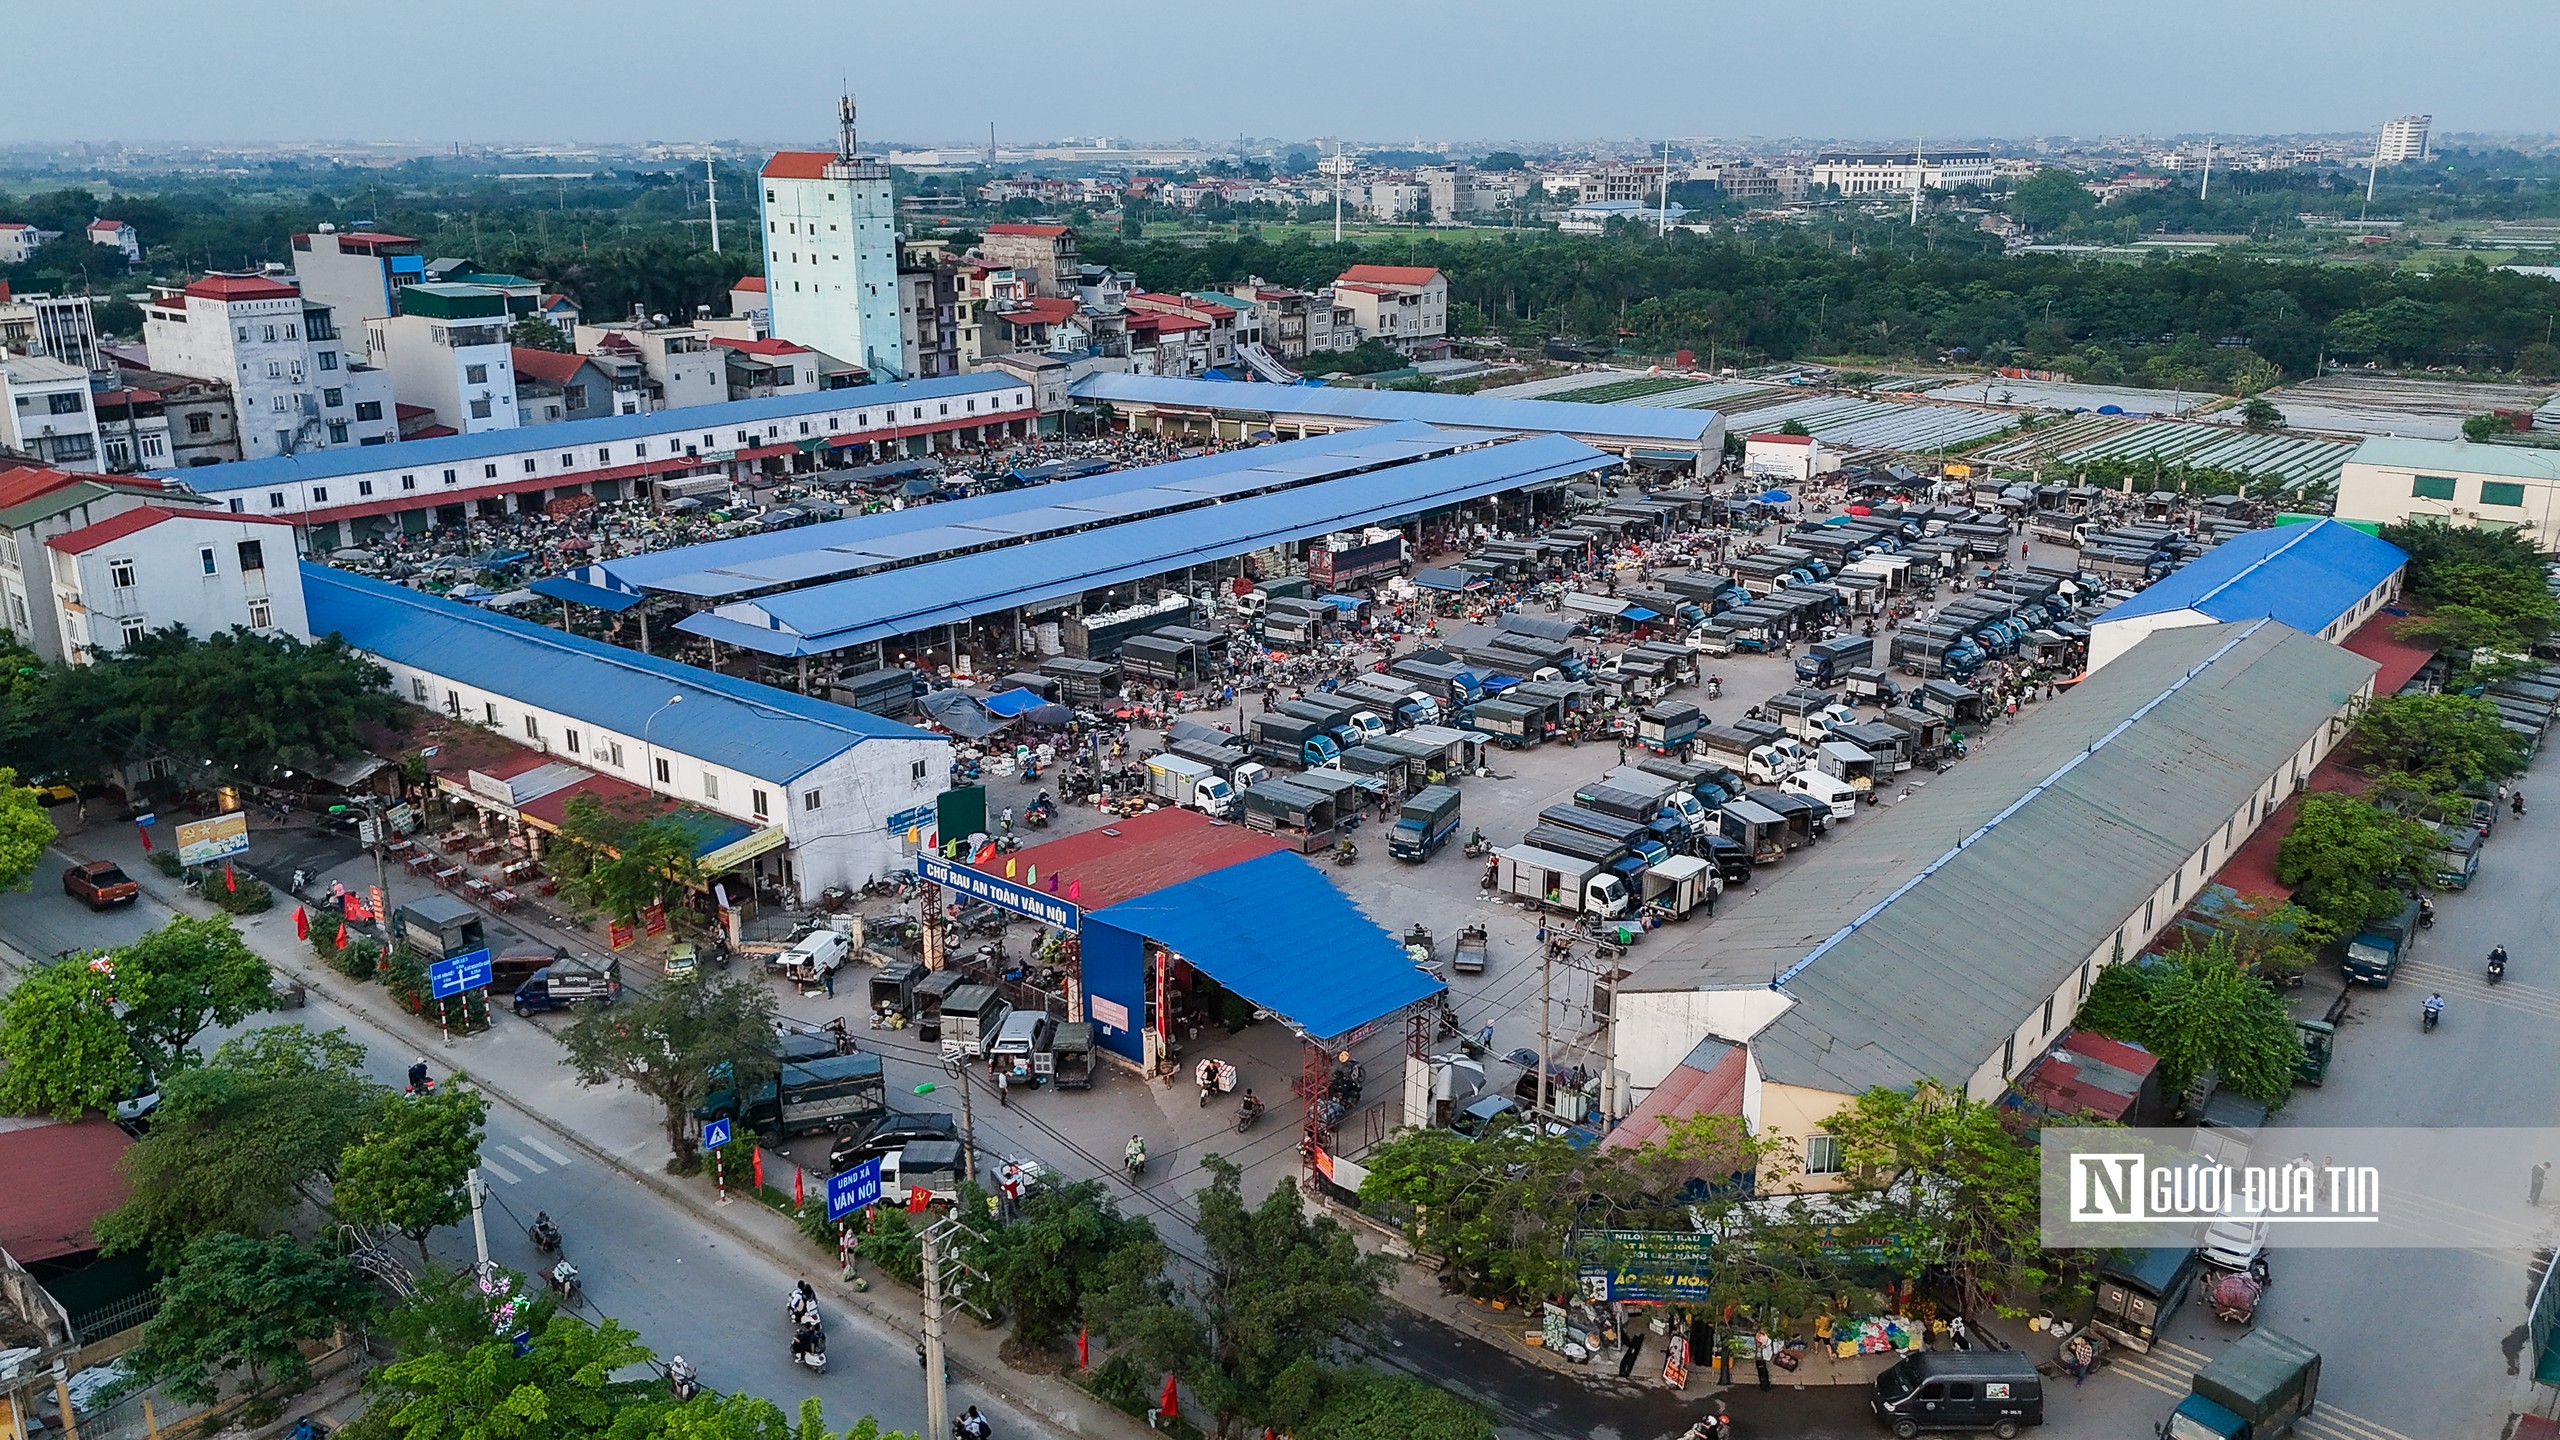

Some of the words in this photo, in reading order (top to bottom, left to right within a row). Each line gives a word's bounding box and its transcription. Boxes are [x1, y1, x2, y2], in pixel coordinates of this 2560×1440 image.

[926, 863, 948, 883] CHỢ
[950, 869, 970, 889] RAU
[972, 879, 988, 895] AN
[990, 884, 1019, 908] TOÀN
[1021, 895, 1044, 917] VÂN
[1046, 905, 1067, 926] NỘI
[838, 1172, 858, 1189] UBND
[860, 1165, 870, 1180] XÃ
[834, 1191, 855, 1211] VÂN
[858, 1180, 876, 1200] NỘI
